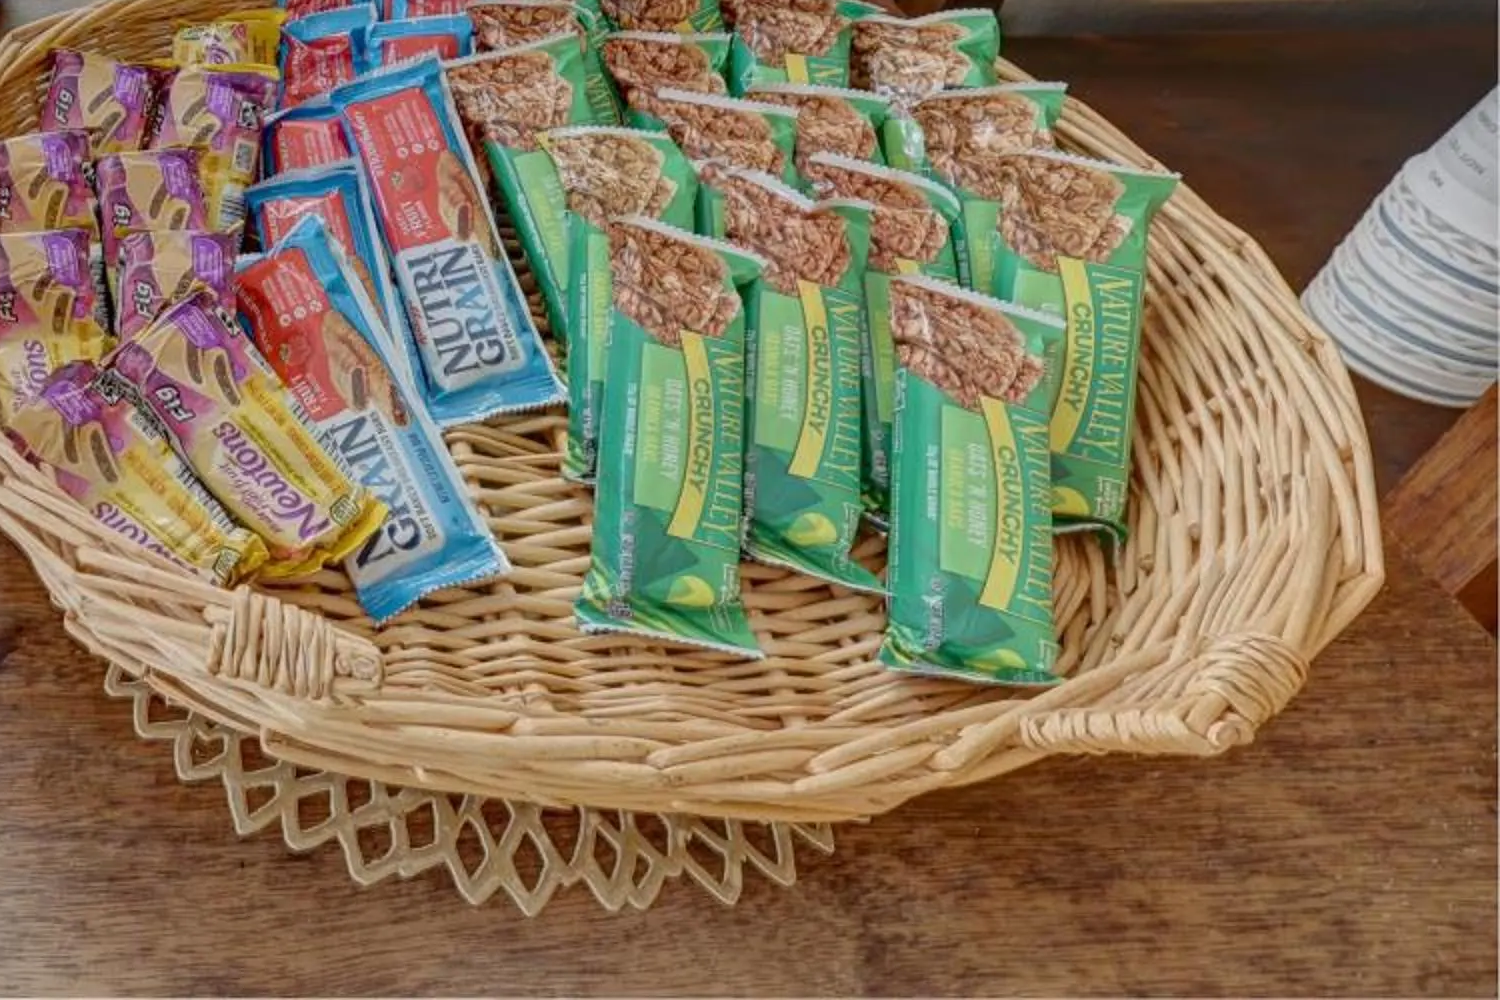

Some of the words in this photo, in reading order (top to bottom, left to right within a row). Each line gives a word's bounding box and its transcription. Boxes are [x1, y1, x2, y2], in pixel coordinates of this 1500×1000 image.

[405, 252, 480, 376] NUTRI
[438, 245, 505, 367] GRAIN
[826, 296, 860, 389] NATURE
[1092, 272, 1133, 367] NATURE
[155, 384, 197, 424] Fig
[710, 348, 743, 444] NATURE
[809, 325, 829, 437] CRUNCHY
[1064, 302, 1094, 412] CRUNCHY
[689, 377, 713, 495] CRUNCHY
[823, 395, 860, 479] VALLEY
[1076, 371, 1125, 456] VALLEY
[210, 420, 331, 541] Newtons
[701, 452, 740, 540] VALLEY
[998, 445, 1021, 566] CRUNCHY
[1011, 414, 1051, 516] NATURE
[1015, 523, 1052, 617] VALLEY
